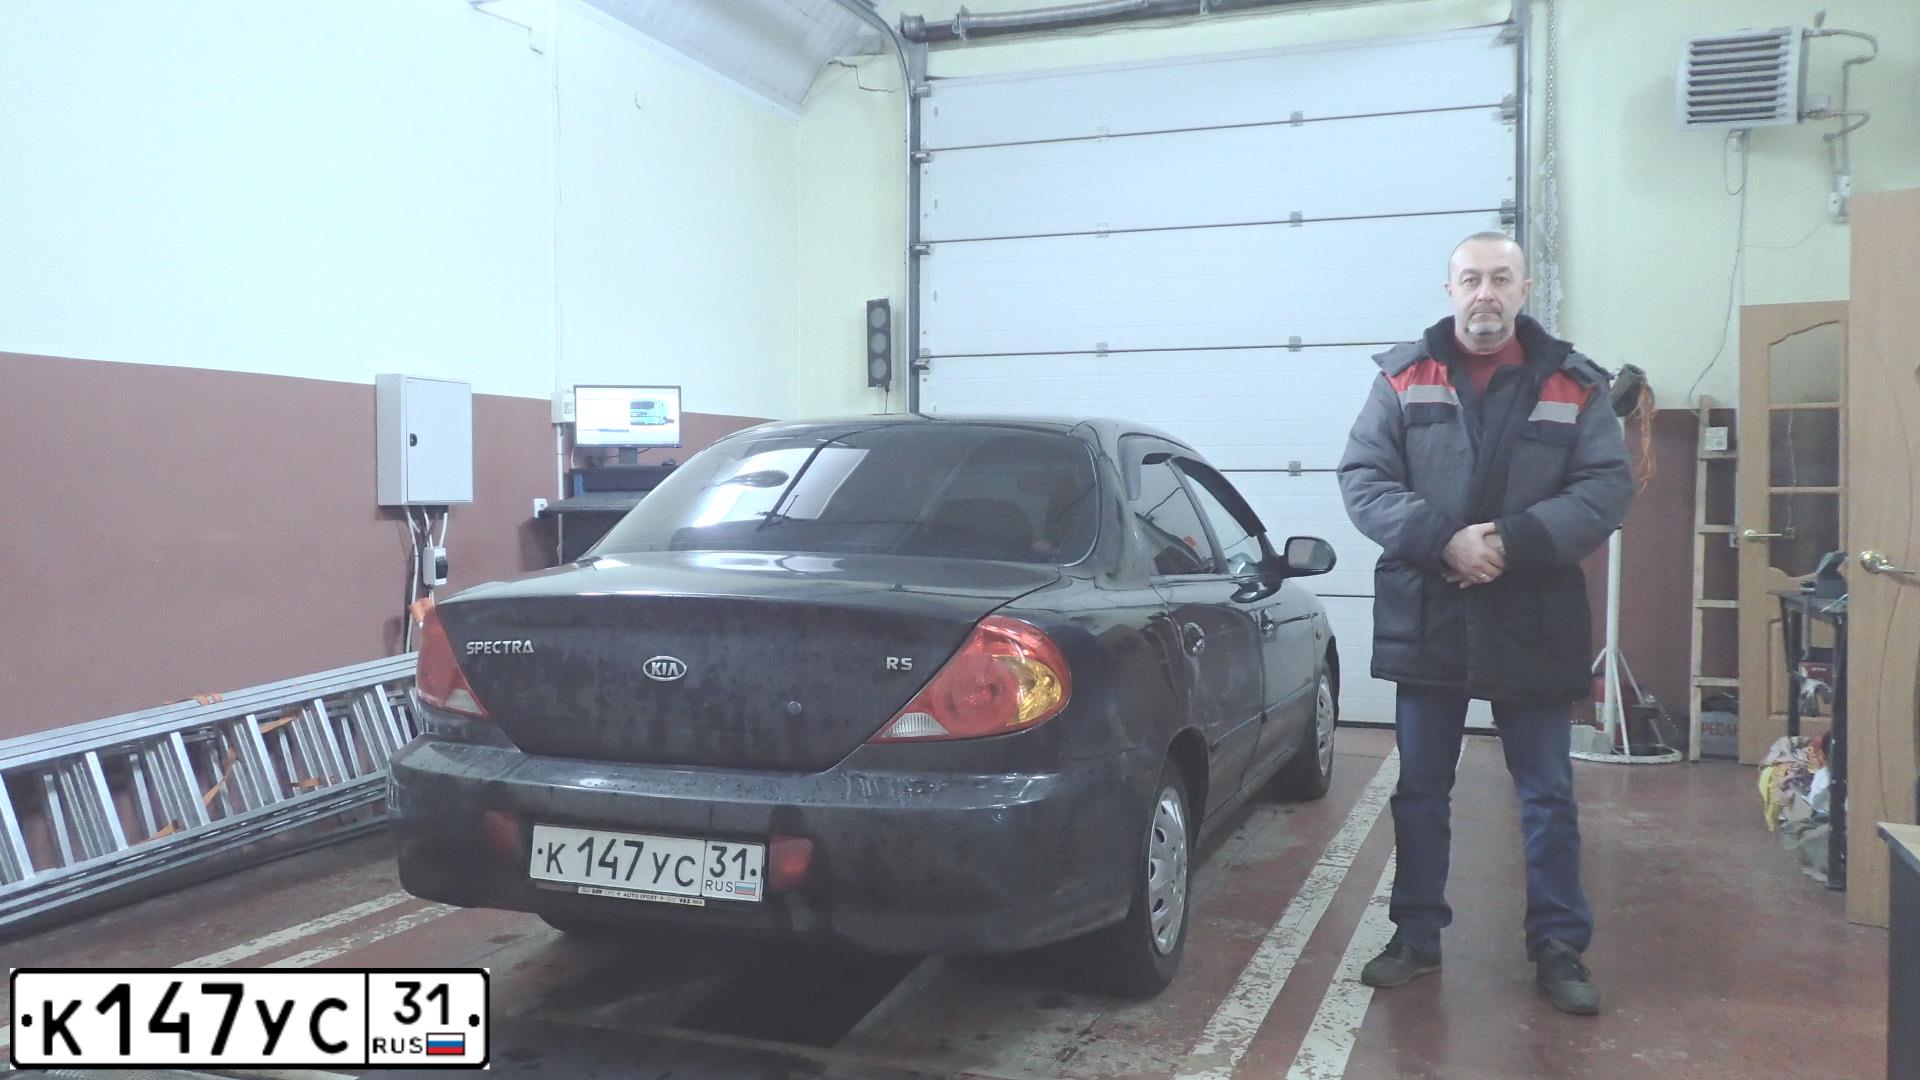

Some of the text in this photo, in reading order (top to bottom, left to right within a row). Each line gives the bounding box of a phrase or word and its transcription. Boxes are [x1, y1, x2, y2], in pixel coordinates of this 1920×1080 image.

[466, 640, 535, 655] SPECTRA
[651, 662, 680, 677] KIA
[886, 656, 913, 671] RS
[709, 844, 748, 881] 31
[704, 880, 734, 893] RUS
